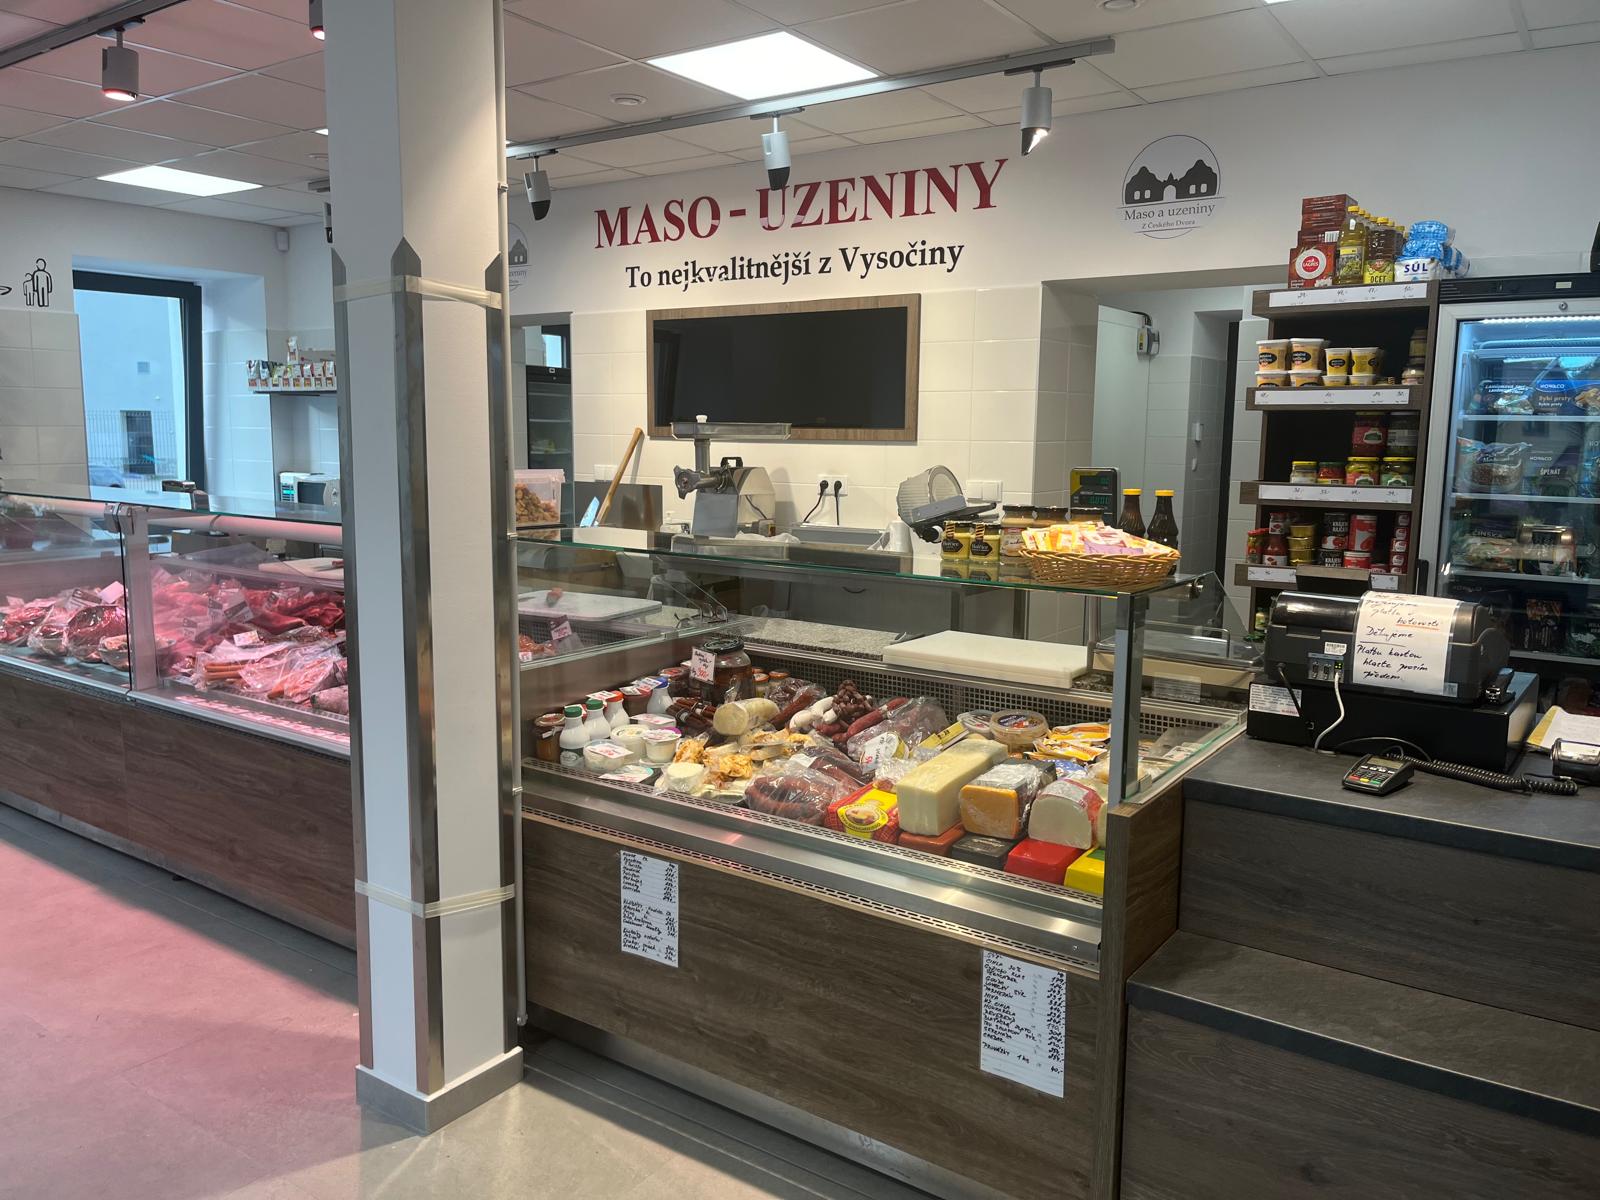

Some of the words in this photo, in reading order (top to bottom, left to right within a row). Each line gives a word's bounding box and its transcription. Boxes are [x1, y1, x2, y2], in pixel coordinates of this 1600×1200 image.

[594, 196, 720, 249] MASO
[756, 159, 1008, 231] UZENINY
[1124, 209, 1155, 220] Maso
[1158, 209, 1164, 218] a
[1168, 204, 1215, 217] uzeniny
[626, 266, 652, 289] To
[658, 250, 811, 291] nejkvalitnější
[819, 256, 832, 274] z
[839, 240, 964, 280] Vysočiny
